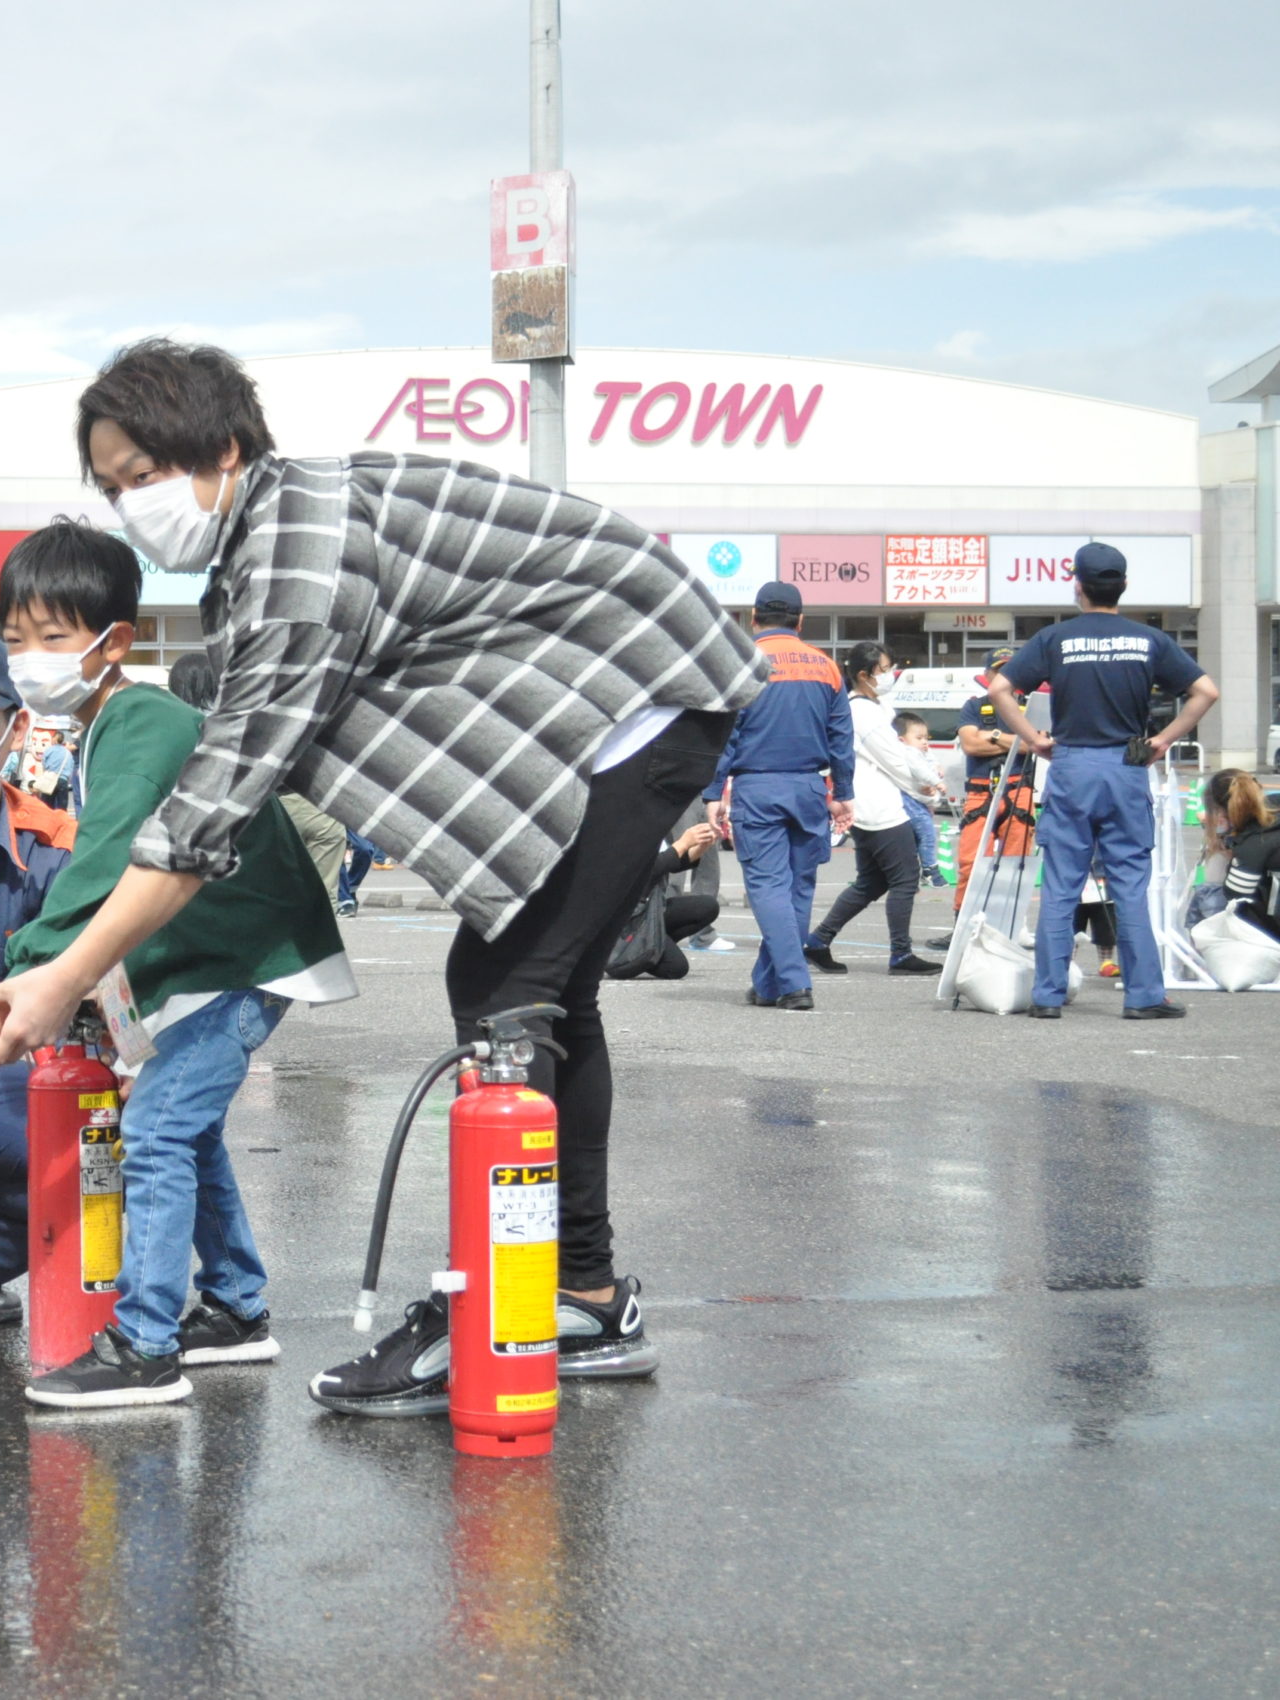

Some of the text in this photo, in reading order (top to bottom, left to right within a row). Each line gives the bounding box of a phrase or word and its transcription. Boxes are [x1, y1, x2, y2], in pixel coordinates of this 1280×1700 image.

[506, 186, 552, 255] B
[590, 381, 823, 443] TOWN
[893, 568, 979, 581] スポーツクラブ
[893, 585, 947, 600] アクトス
